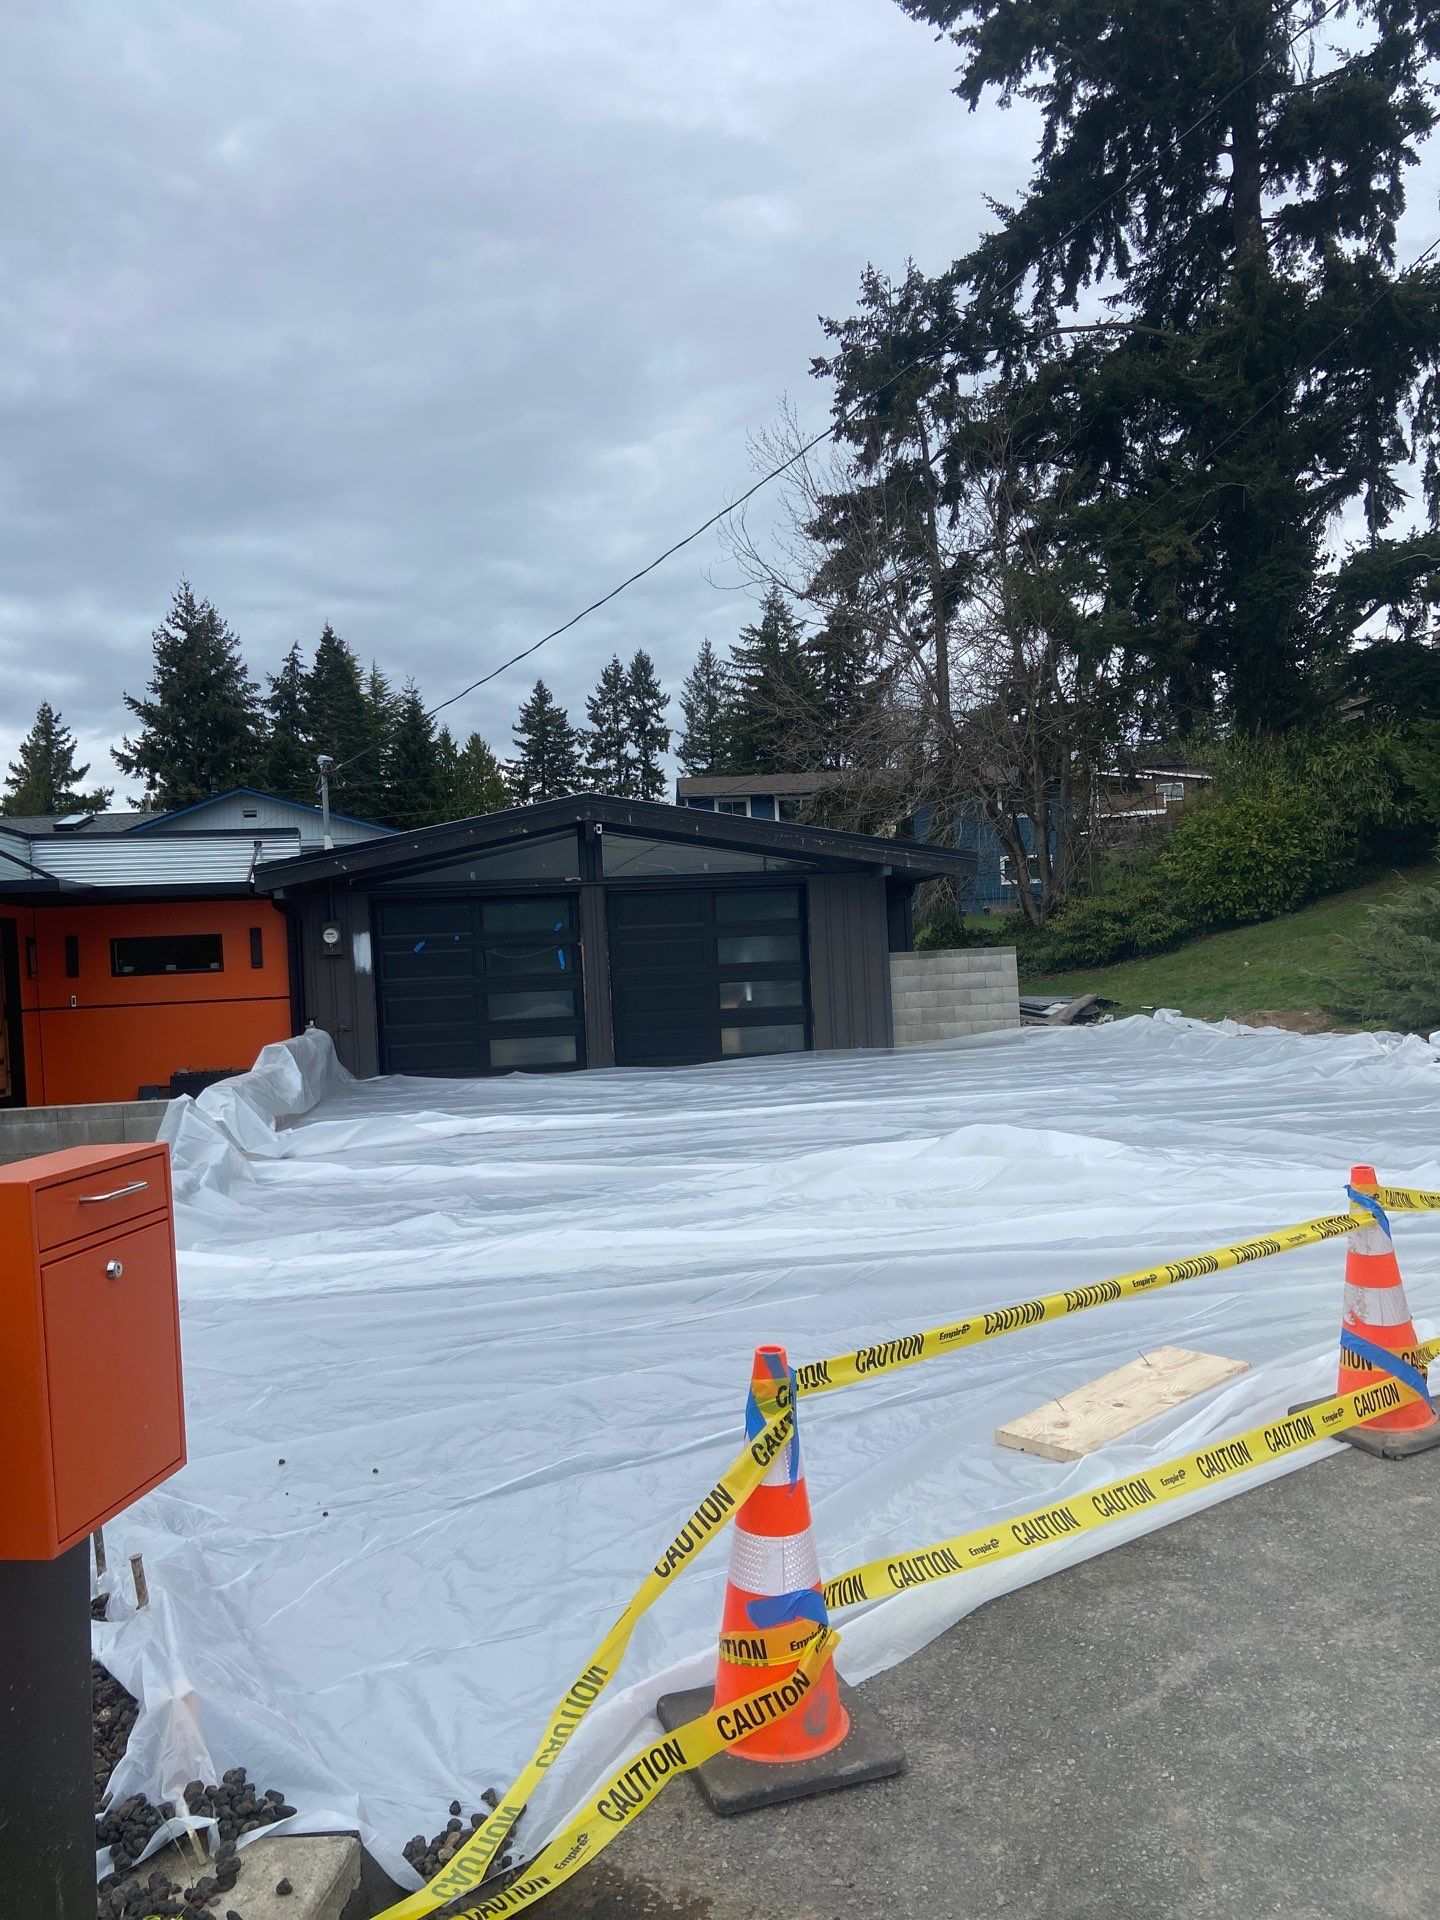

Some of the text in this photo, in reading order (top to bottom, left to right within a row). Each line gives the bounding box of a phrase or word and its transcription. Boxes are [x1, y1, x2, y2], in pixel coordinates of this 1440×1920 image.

[855, 1333, 925, 1374] CAUTION
[939, 1326, 968, 1341] Empire
[983, 1300, 1045, 1335] CAUTION
[1063, 1280, 1122, 1312] CAUTION
[1132, 1274, 1156, 1289] Empire
[1165, 1255, 1219, 1283] CAUTION
[1230, 1238, 1281, 1265] CAUTION
[1310, 1214, 1360, 1239] CAUTION
[653, 1483, 736, 1578] CAUTION
[887, 1547, 963, 1589] CAUTION
[968, 1540, 997, 1557] Empire
[1011, 1506, 1082, 1546] CAUTION
[1091, 1478, 1157, 1518] CAUTION
[1160, 1471, 1184, 1487] Empire
[1195, 1440, 1253, 1479] CAUTION
[1263, 1414, 1317, 1453] CAUTION
[1321, 1408, 1342, 1424] Empire
[1353, 1382, 1401, 1418] CAUTION
[597, 1668, 811, 1822] CAUTION CAUTION
[553, 1837, 589, 1871] Empire
